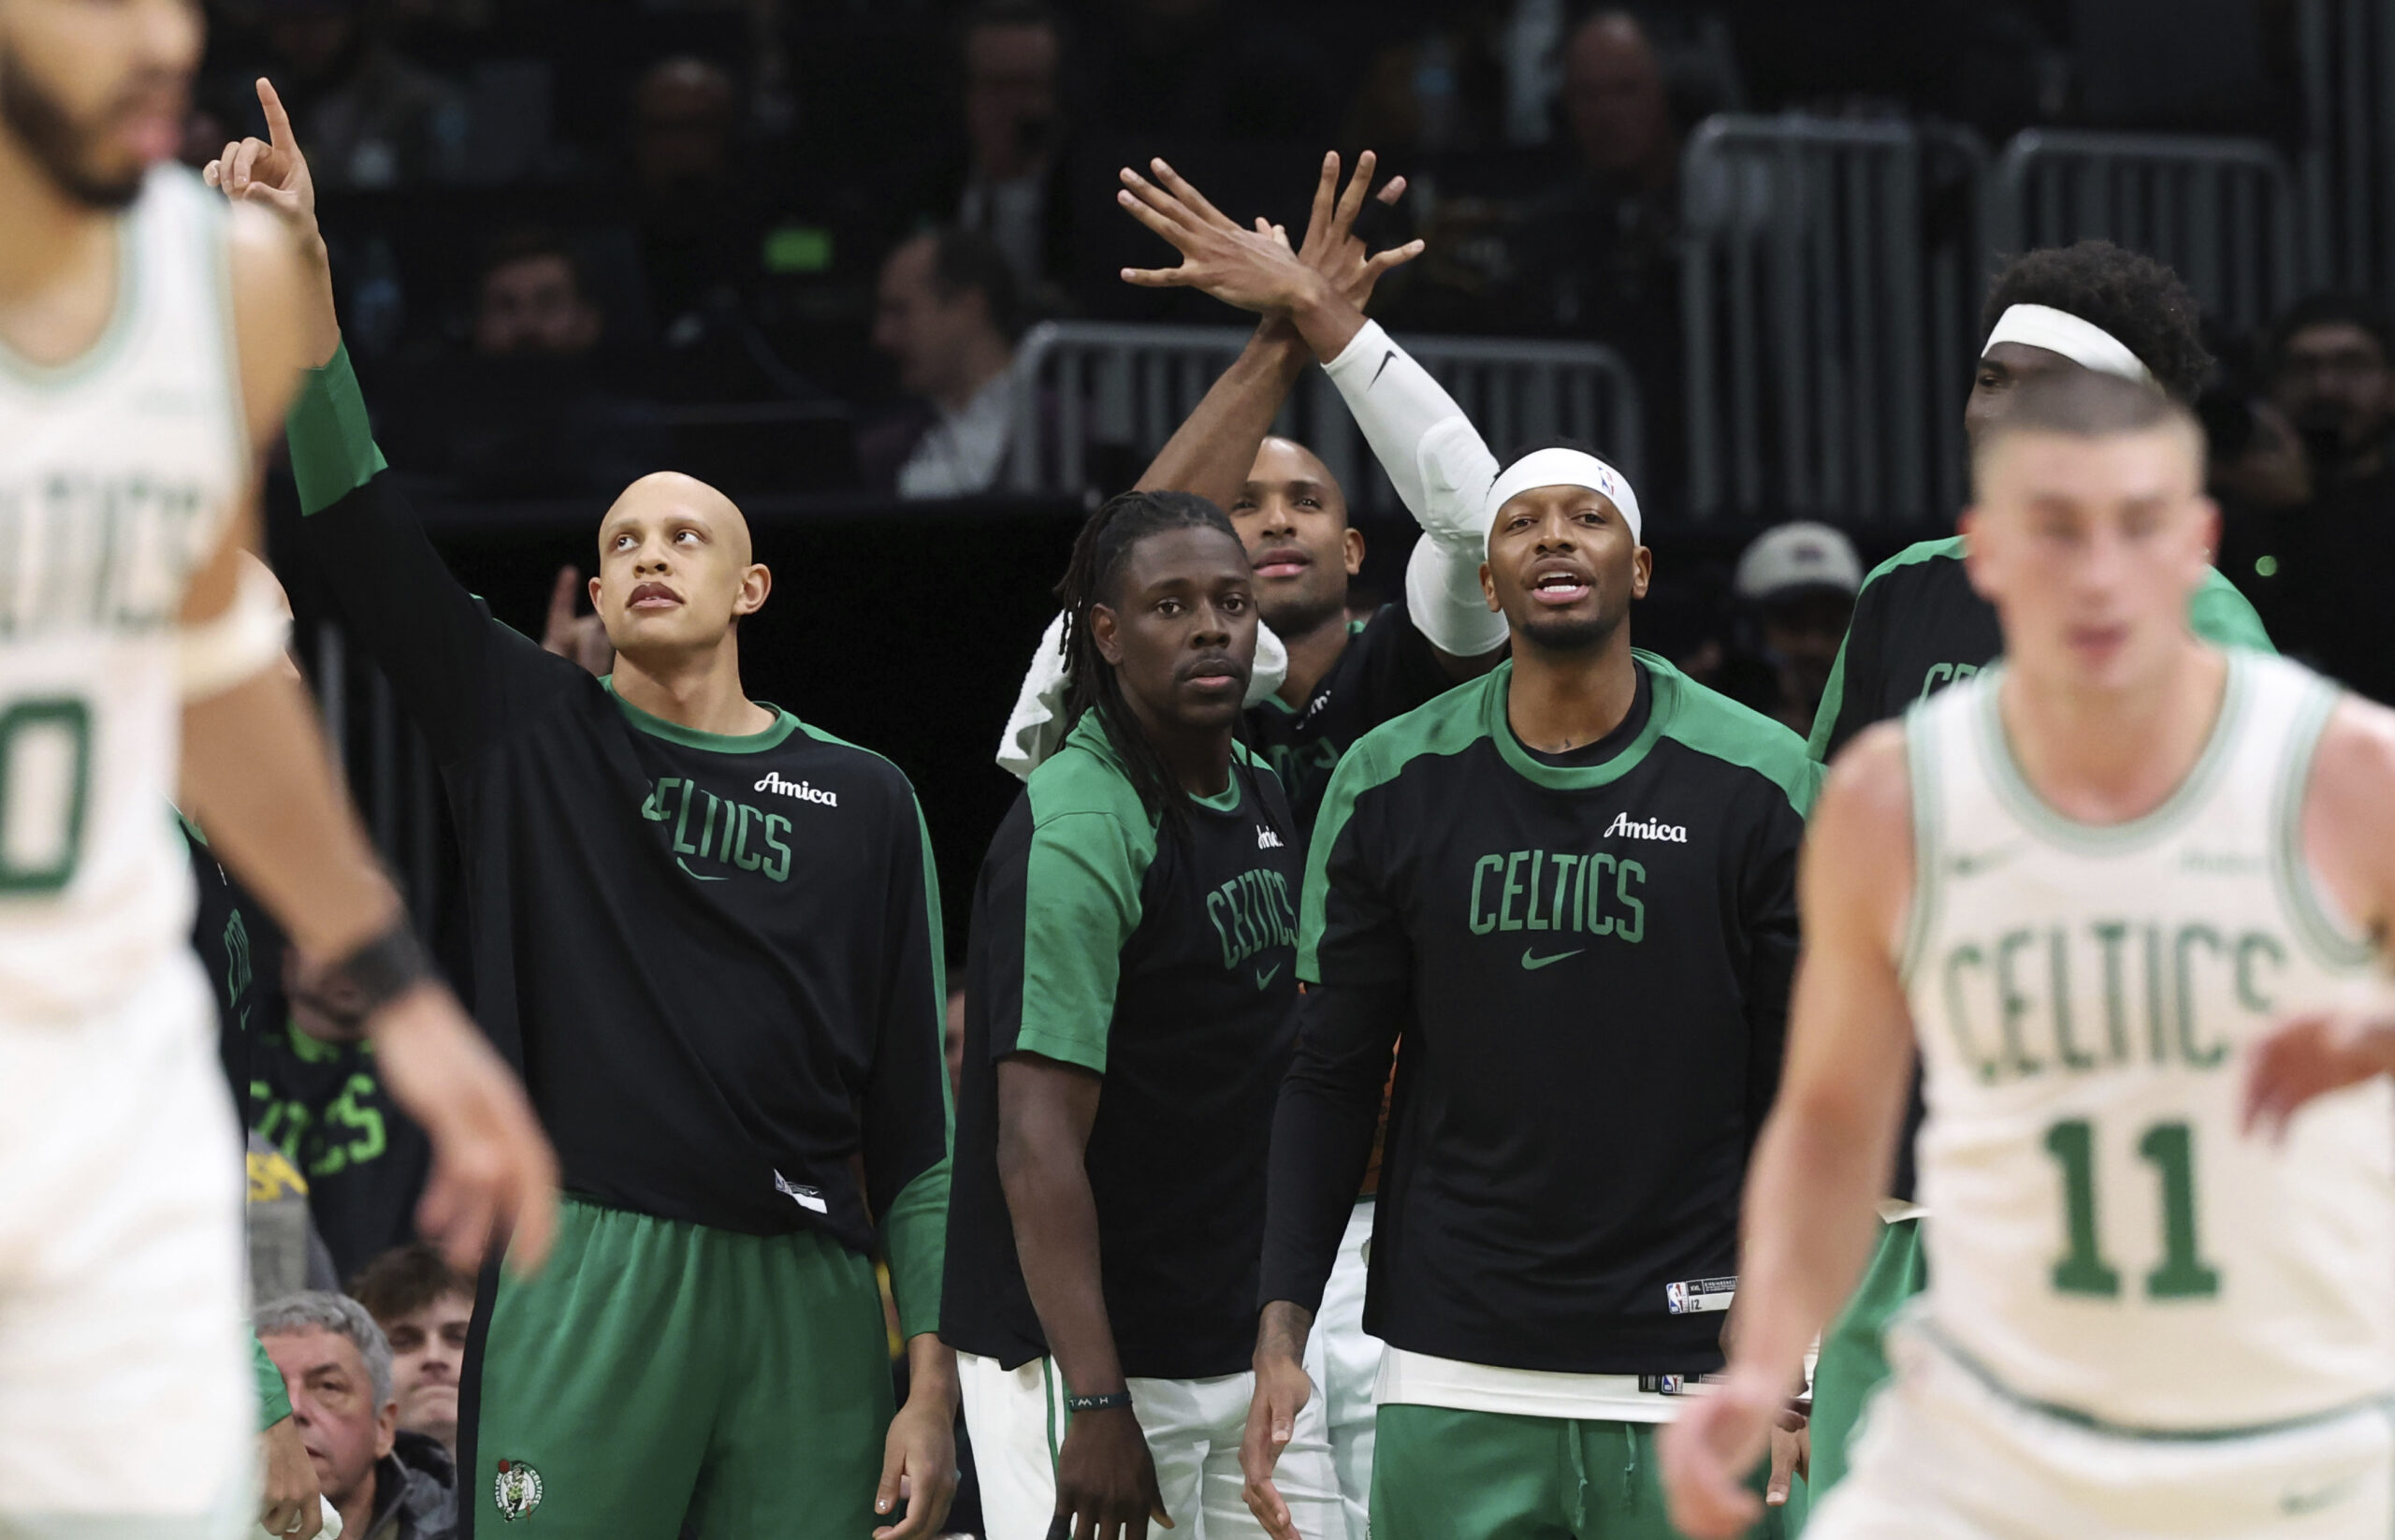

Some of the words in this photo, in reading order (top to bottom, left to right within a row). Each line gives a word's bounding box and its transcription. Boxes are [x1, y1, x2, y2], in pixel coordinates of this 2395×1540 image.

[753, 771, 838, 807] Amica
[1603, 811, 1689, 843] Amica
[1468, 849, 1647, 945] CELTICS
[2041, 1116, 2224, 1300] 11
[1691, 1299, 1703, 1311] 12
